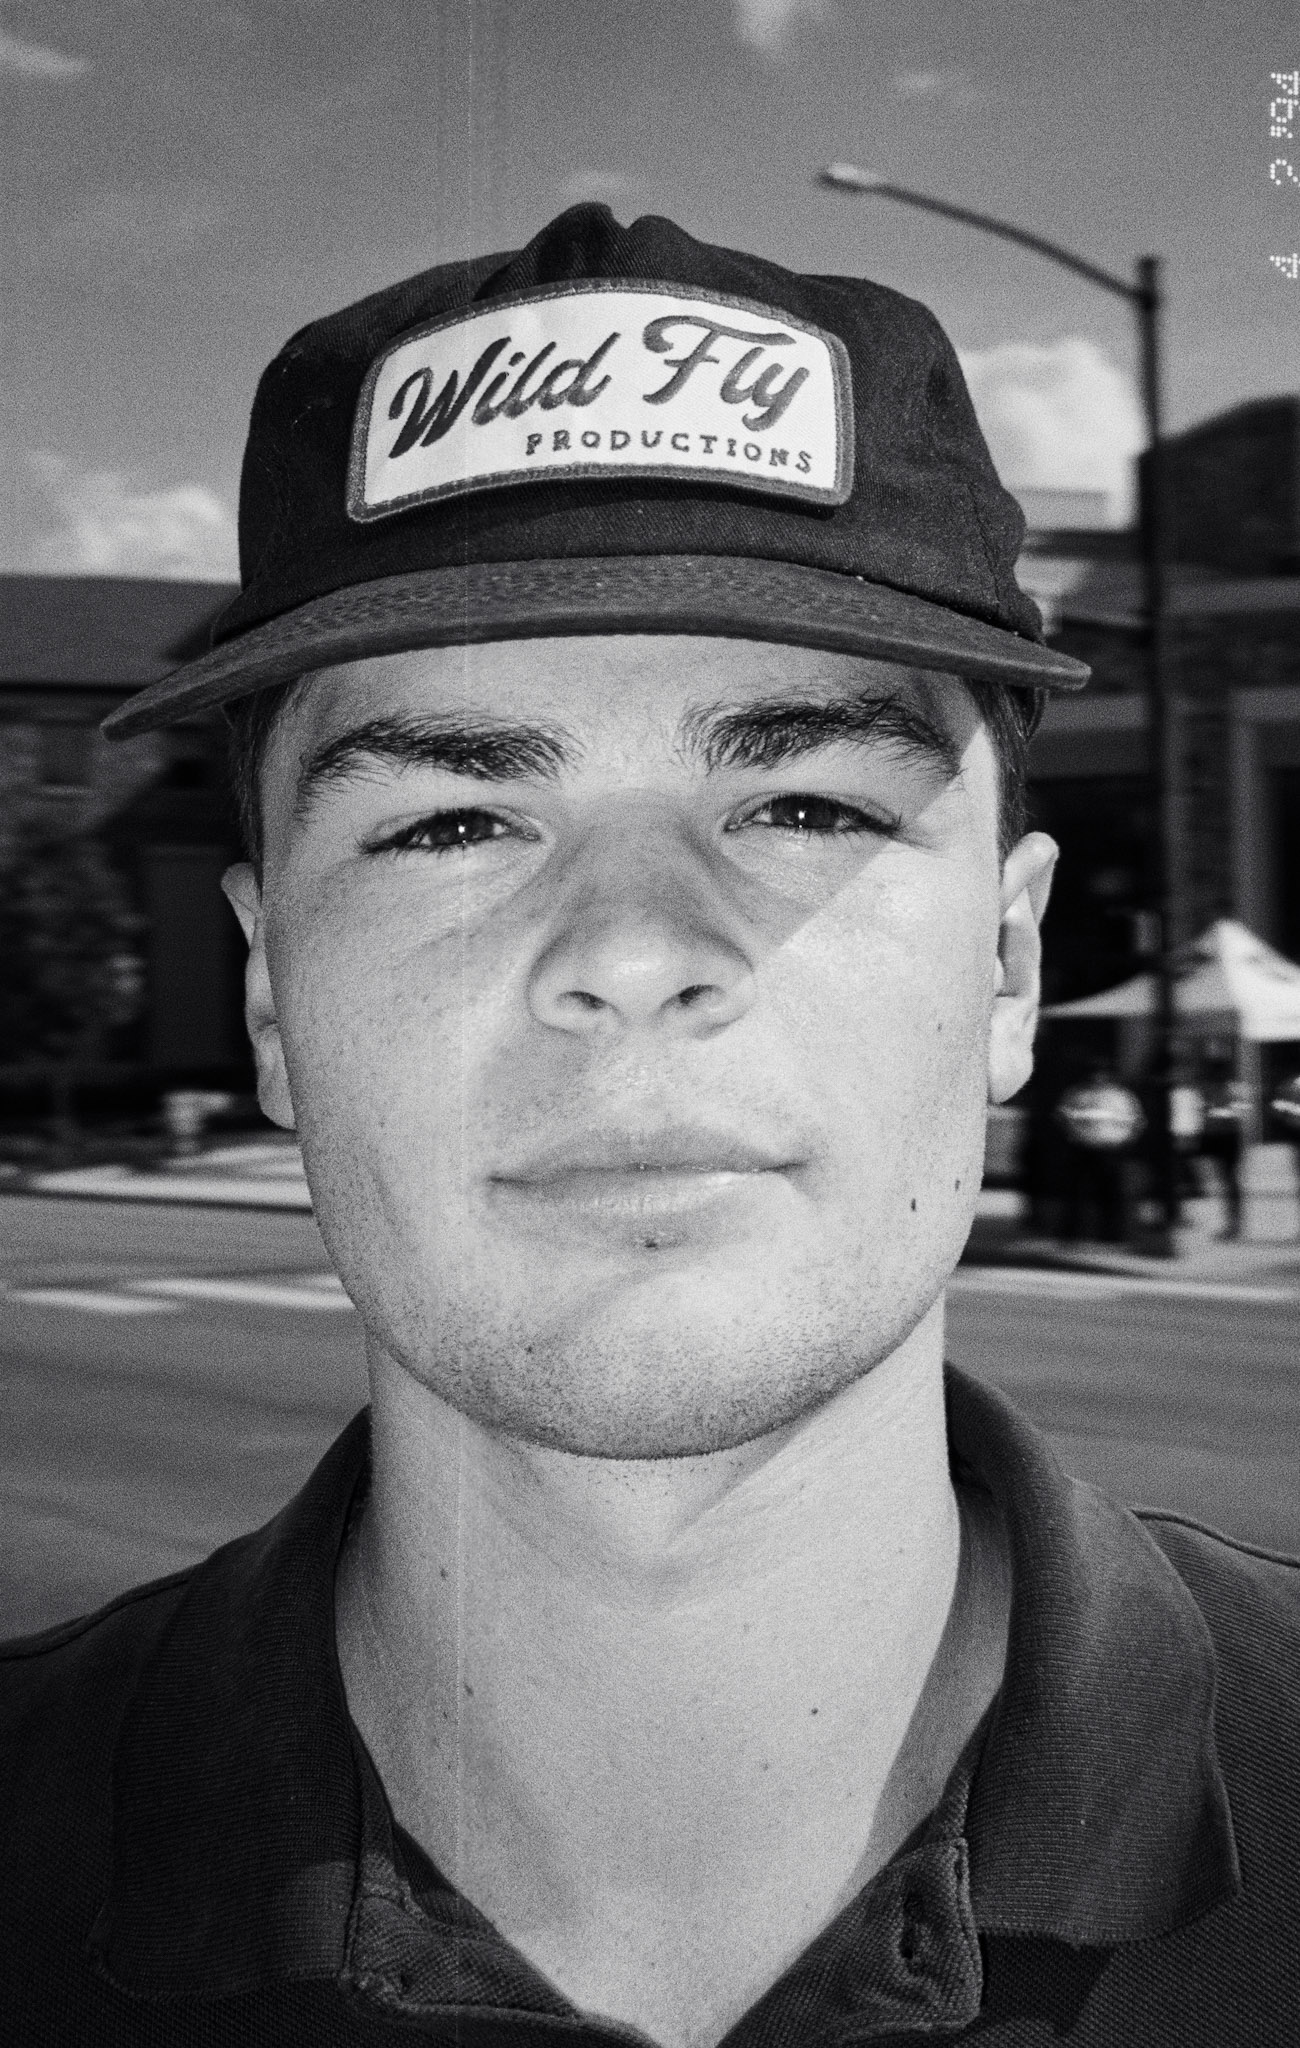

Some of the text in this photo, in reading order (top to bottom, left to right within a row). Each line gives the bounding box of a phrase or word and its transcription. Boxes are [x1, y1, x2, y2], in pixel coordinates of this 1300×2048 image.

[388, 315, 810, 459] Wild Fly
[525, 429, 812, 474] PRODUCTIONS
